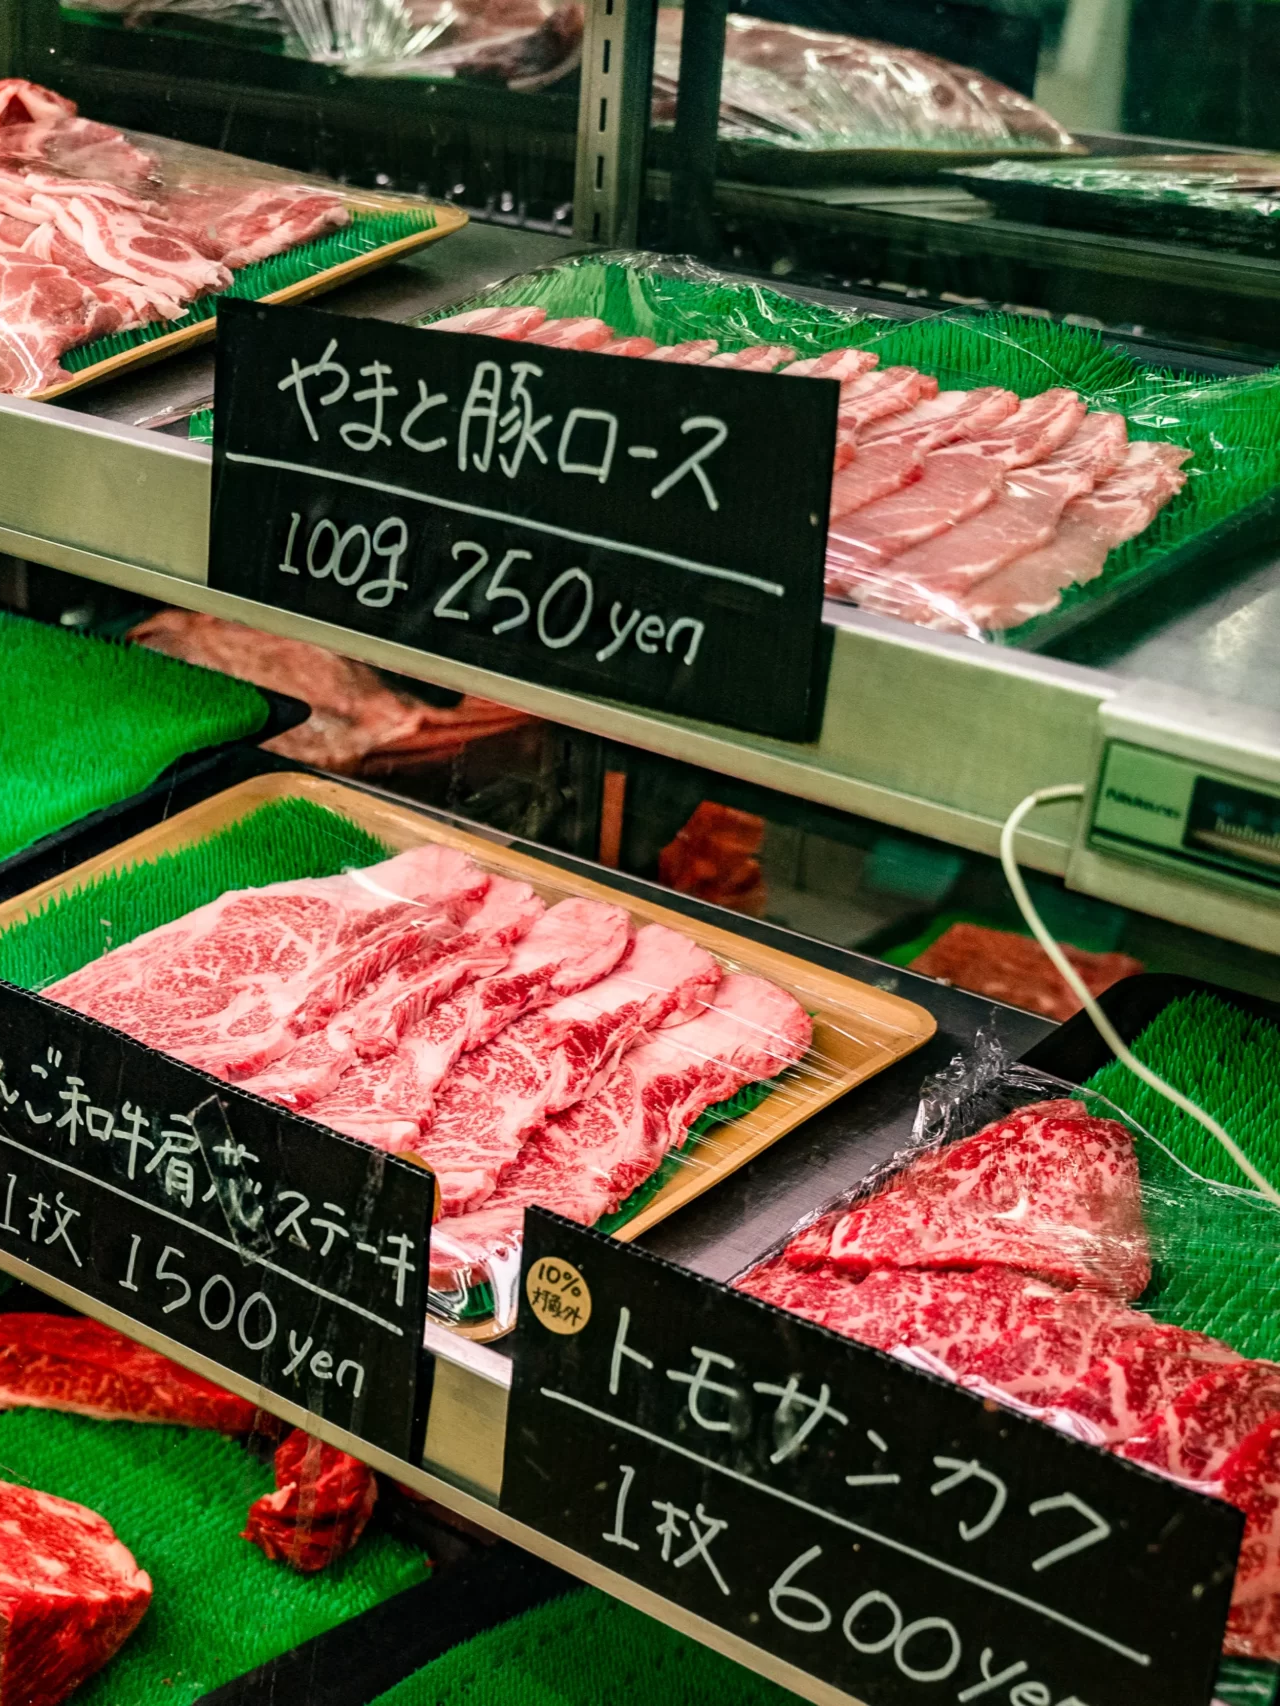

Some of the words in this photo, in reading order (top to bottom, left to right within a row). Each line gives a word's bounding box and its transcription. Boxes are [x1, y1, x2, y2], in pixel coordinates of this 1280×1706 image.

[278, 338, 729, 511] やまと豚ロース
[278, 512, 409, 607] 100g
[538, 1263, 582, 1297] 10%
[609, 1308, 1111, 1571] トモサンカク
[603, 1465, 730, 1595] 1枚
